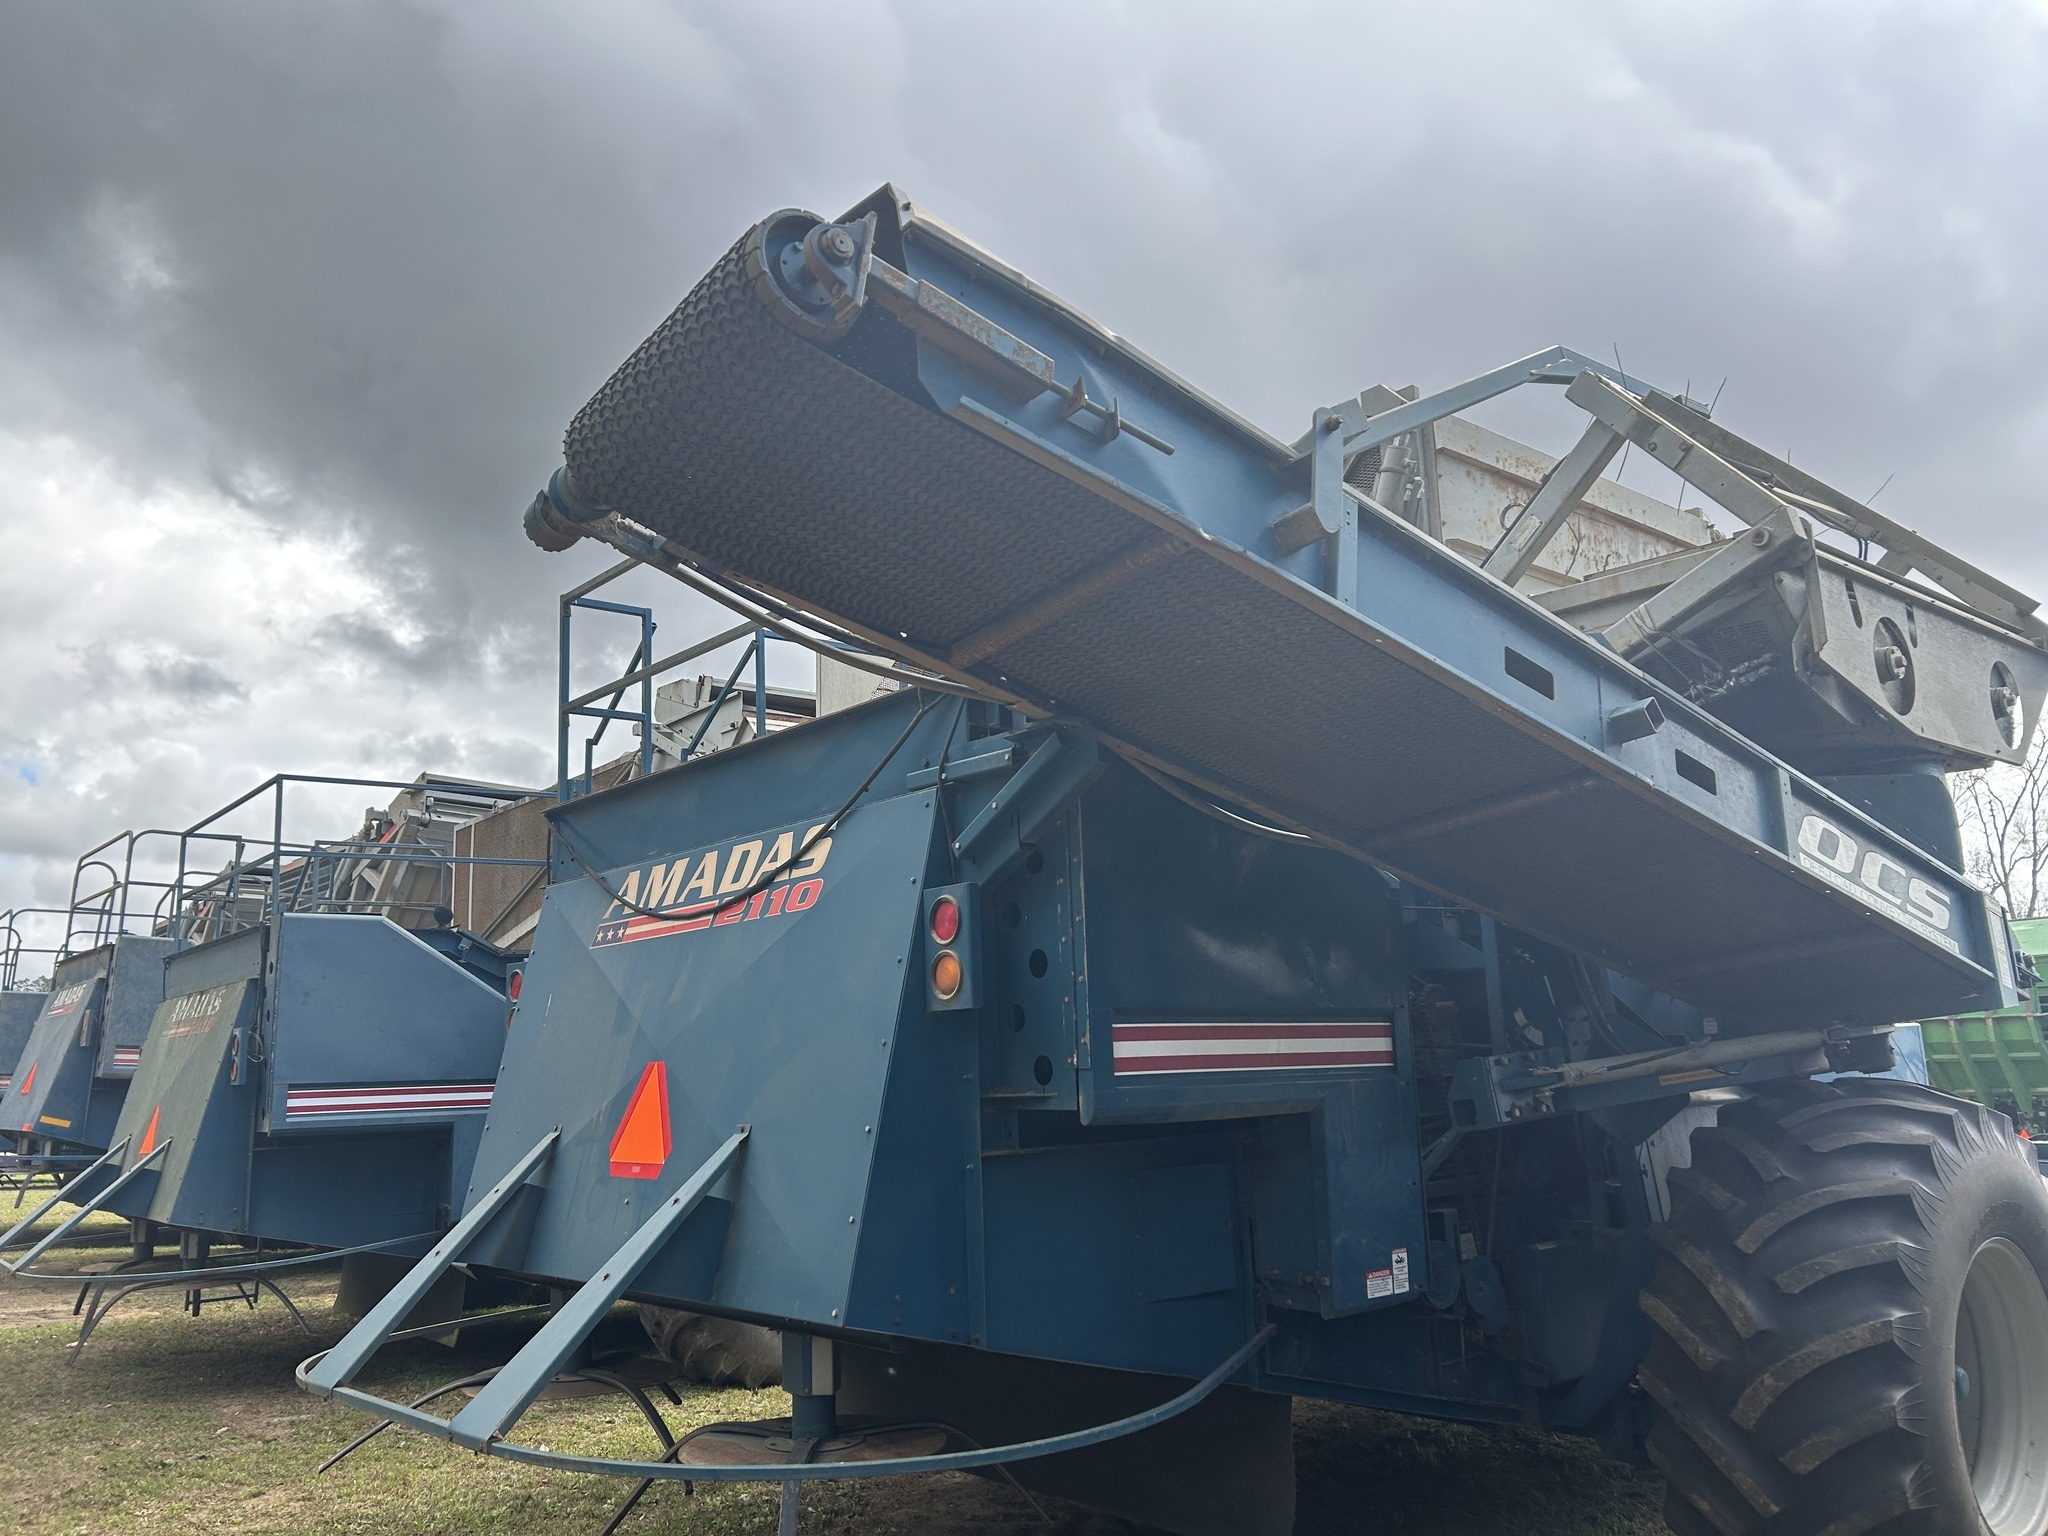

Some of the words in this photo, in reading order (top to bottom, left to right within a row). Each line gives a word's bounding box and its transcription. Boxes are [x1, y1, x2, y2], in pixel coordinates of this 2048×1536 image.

[602, 820, 839, 919] AMADAS
[713, 878, 824, 927] 2110
[1797, 814, 1951, 930] OCS
